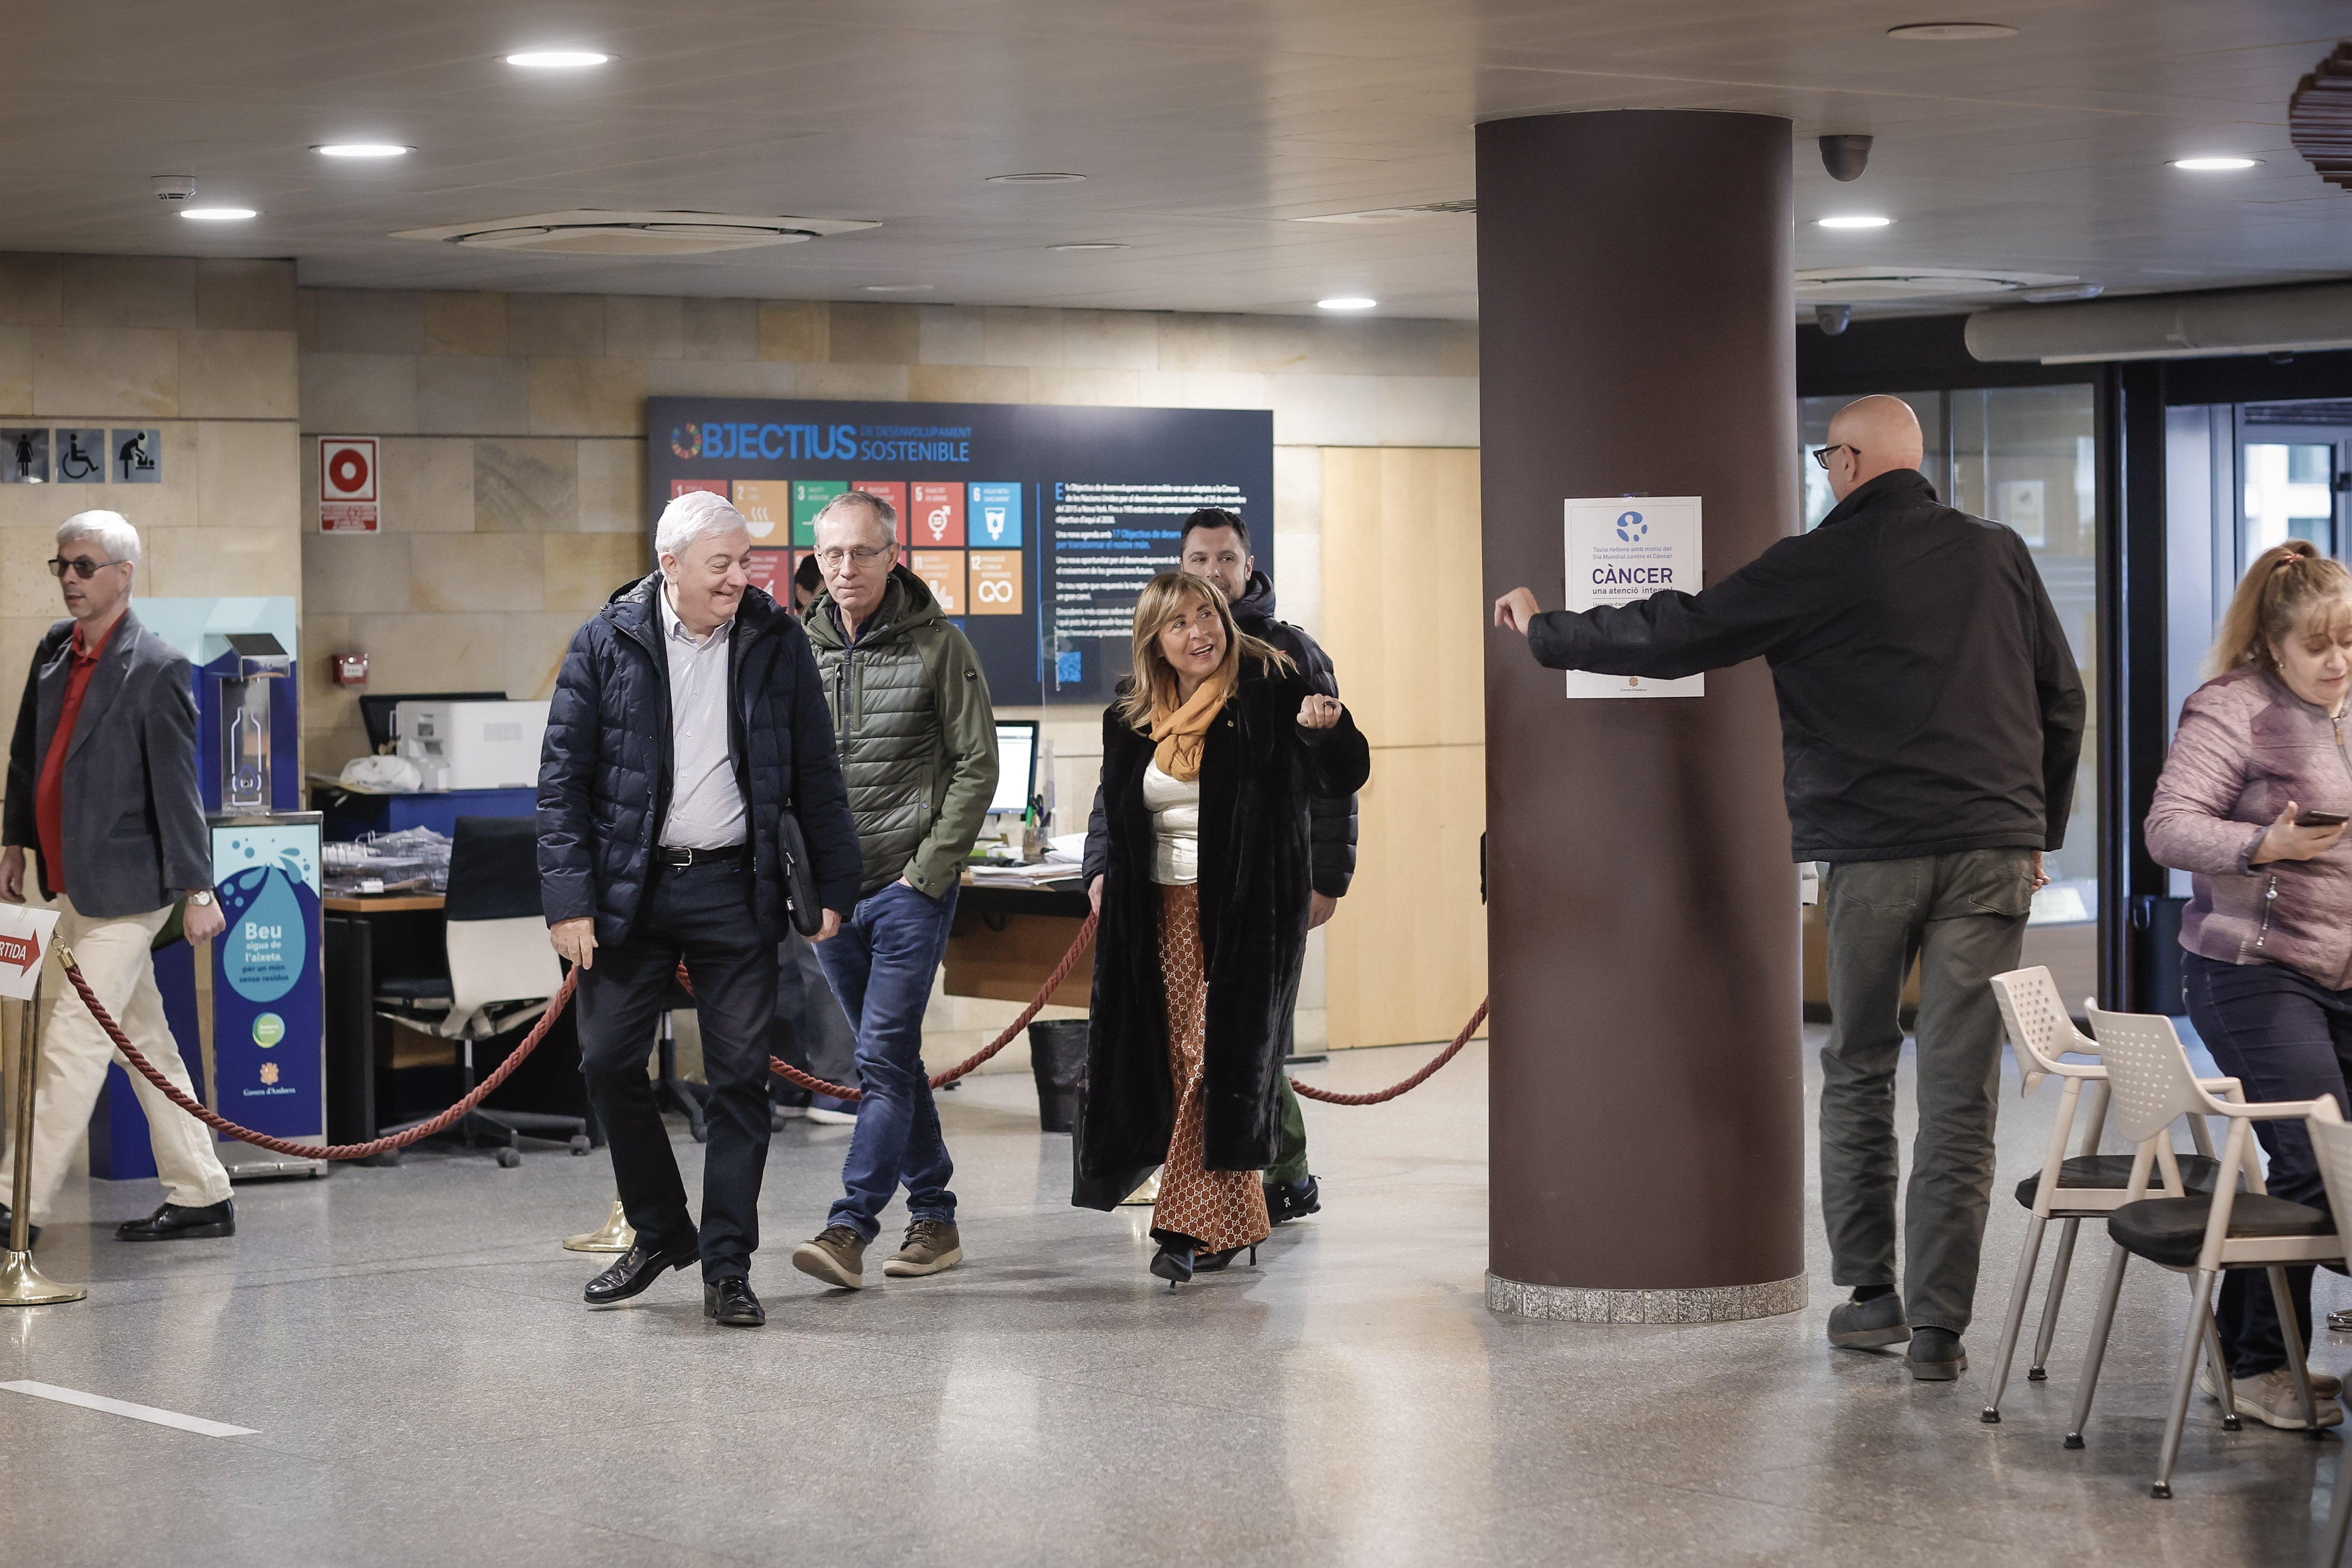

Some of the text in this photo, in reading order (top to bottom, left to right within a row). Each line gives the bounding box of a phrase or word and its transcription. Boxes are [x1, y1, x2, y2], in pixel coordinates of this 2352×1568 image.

[860, 440, 971, 462] SOSTENIBLE
[737, 485, 744, 500] 2
[797, 485, 806, 500] 3
[915, 486, 923, 502] 5
[973, 487, 981, 502] 6
[1592, 564, 1673, 584] CÀNCER
[245, 922, 282, 941] Beu
[246, 939, 282, 952] aigua de
